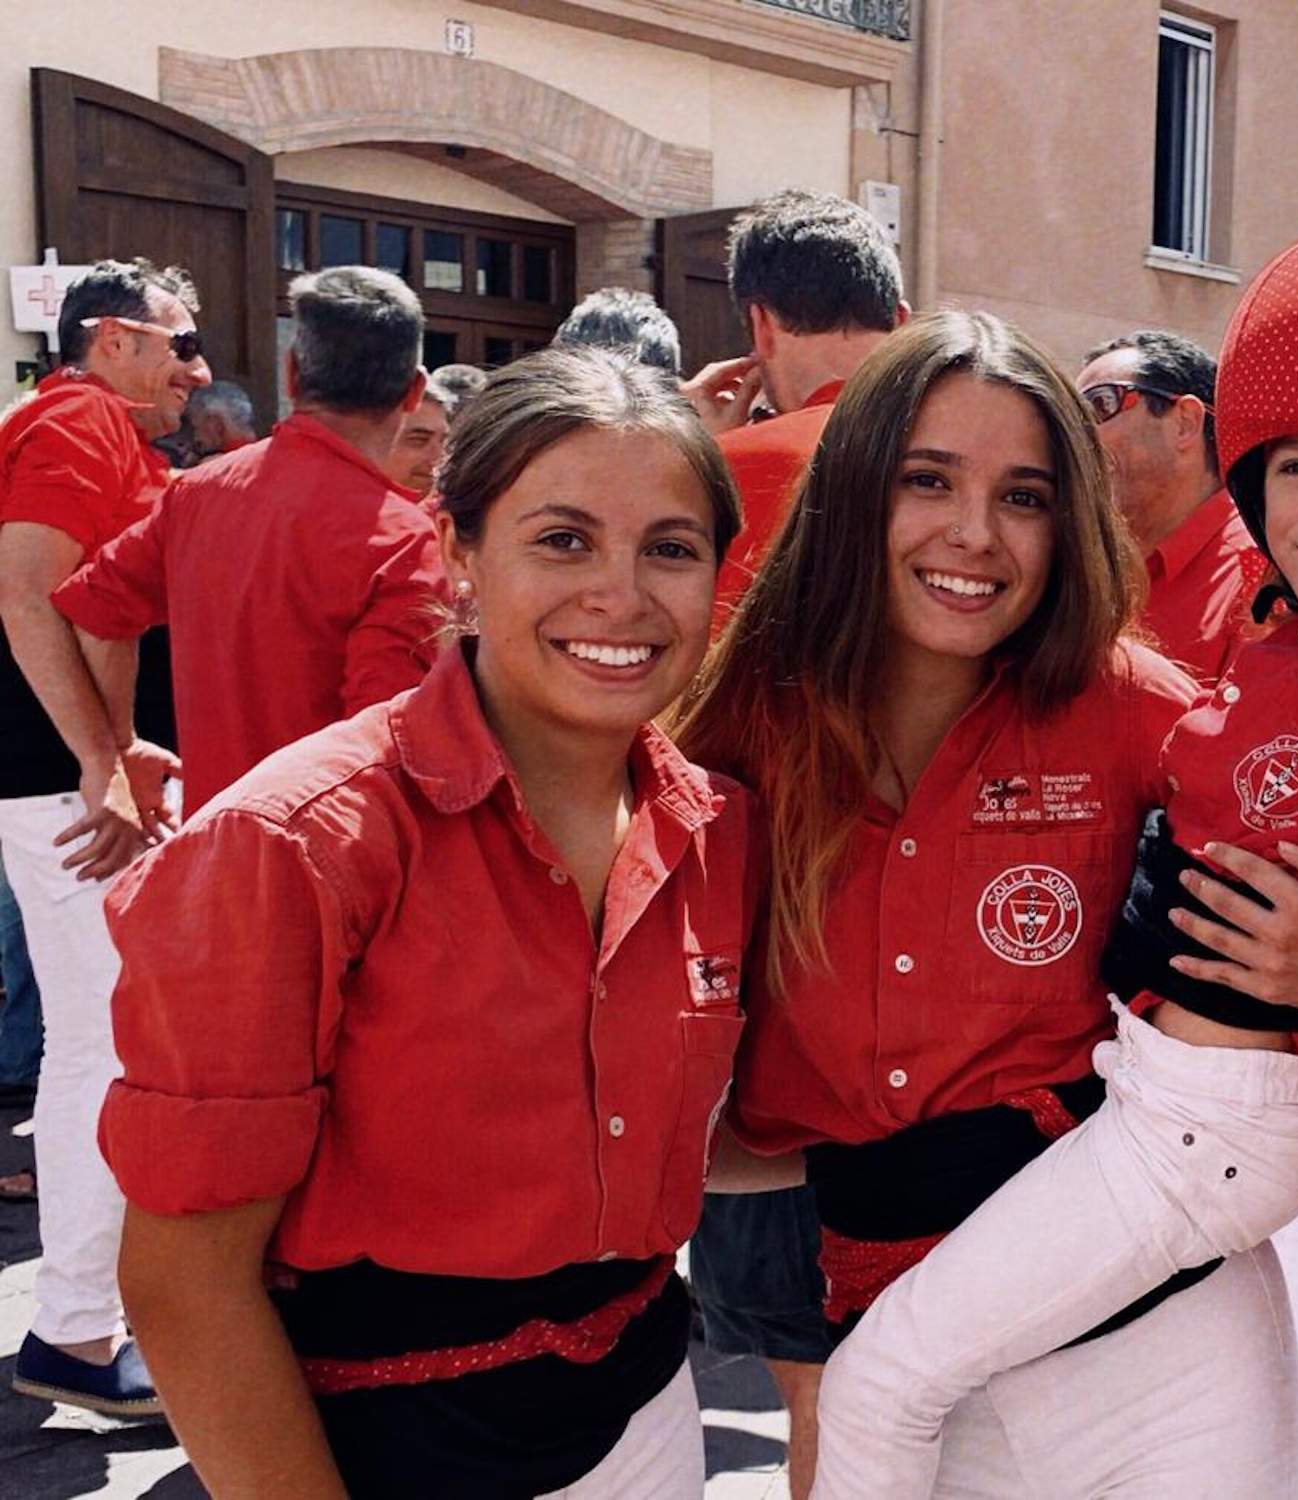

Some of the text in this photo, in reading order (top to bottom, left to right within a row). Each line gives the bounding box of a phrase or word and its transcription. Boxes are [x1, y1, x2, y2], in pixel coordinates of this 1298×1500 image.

[987, 869, 1077, 912] COLLA JOVES
[986, 926, 1072, 961] Xiquets de Valls
